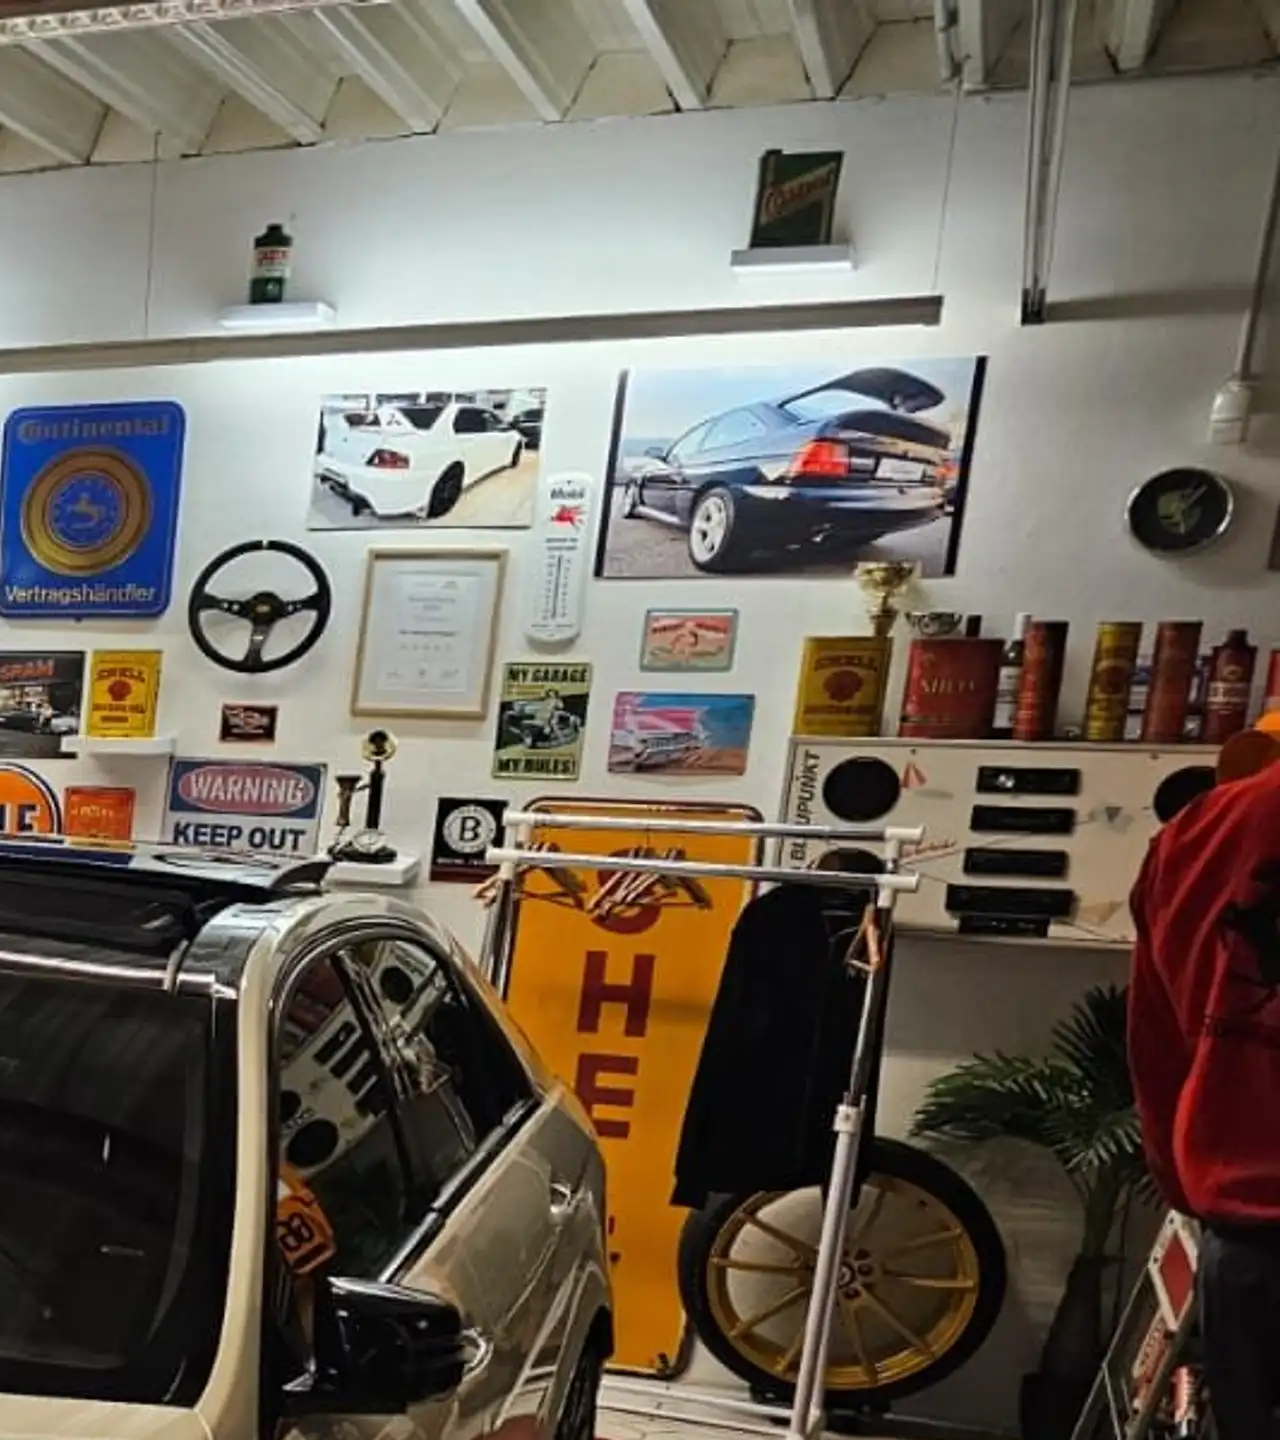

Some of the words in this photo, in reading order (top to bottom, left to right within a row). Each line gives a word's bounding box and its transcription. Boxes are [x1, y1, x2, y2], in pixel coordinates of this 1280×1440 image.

[17, 414, 170, 444] Continental
[4, 583, 156, 606] Vertragshändler
[532, 668, 588, 683] GARAGE
[190, 773, 306, 804] WARNING
[790, 749, 820, 860] BLUPUNKT
[172, 822, 244, 848] KEEP
[247, 827, 307, 851] OUT
